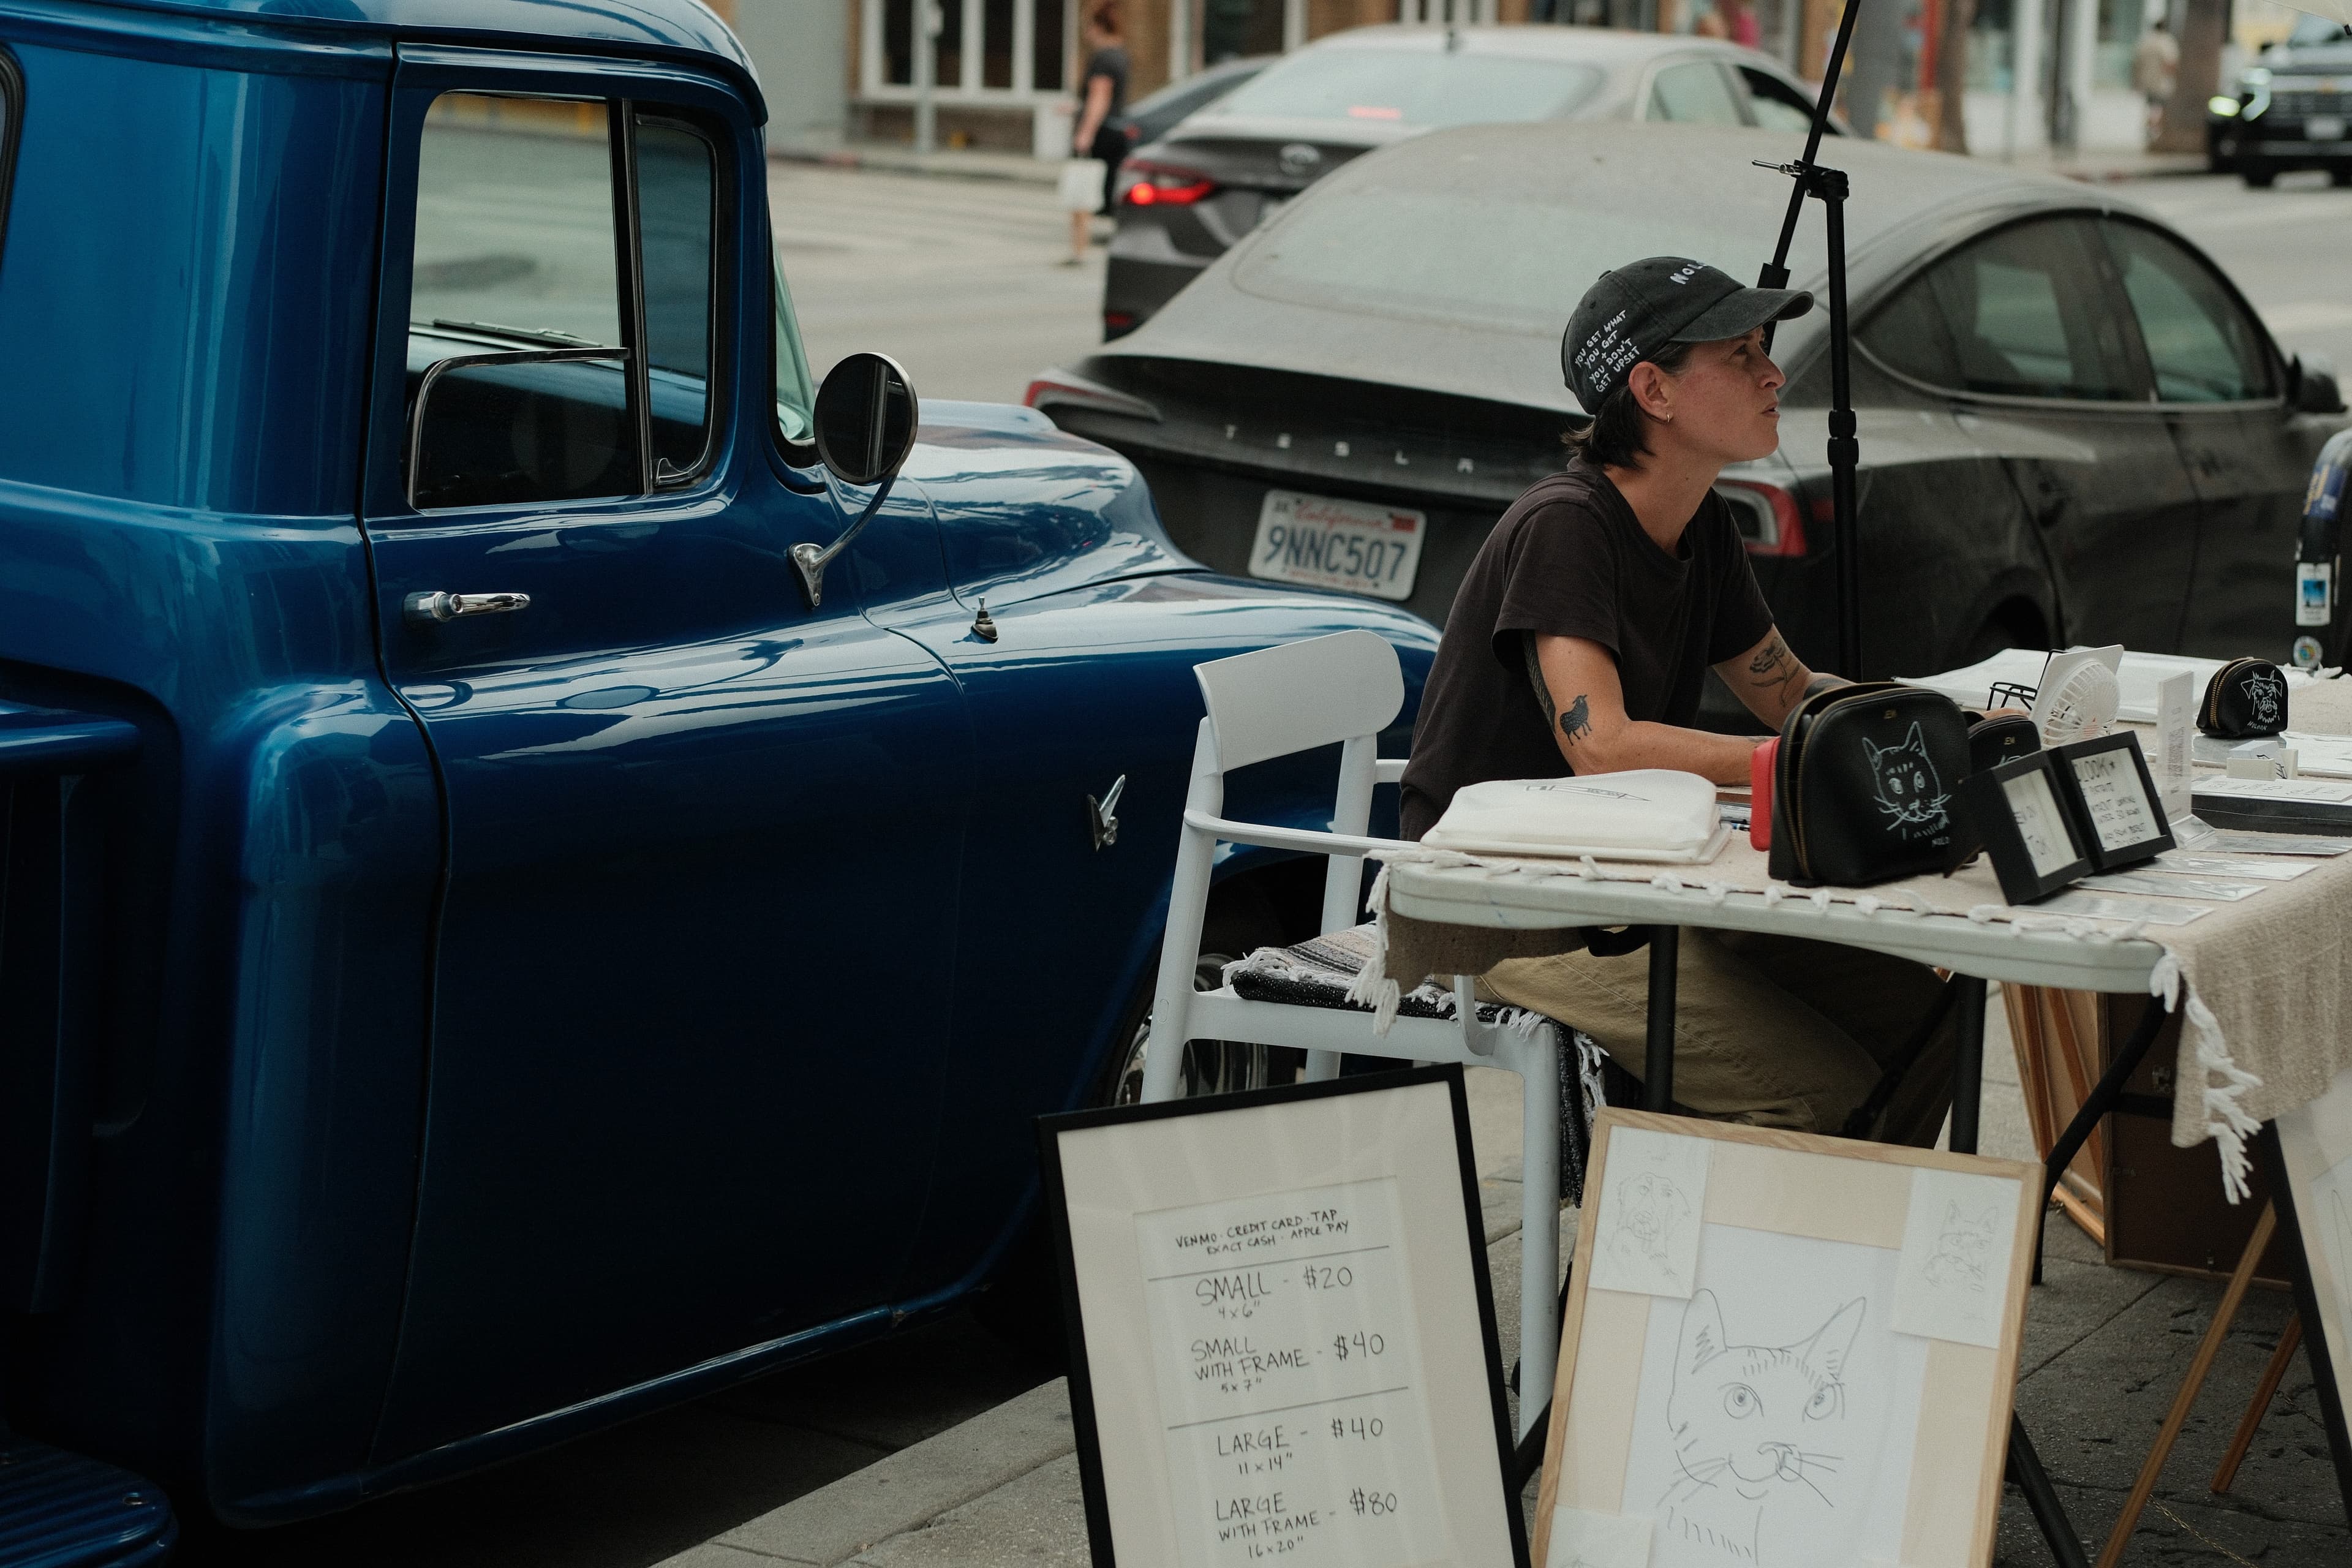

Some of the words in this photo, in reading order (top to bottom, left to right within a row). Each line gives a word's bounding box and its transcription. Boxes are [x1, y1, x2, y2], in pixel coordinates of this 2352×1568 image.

[1670, 262, 1707, 285] NOL
[1575, 347, 1586, 367] YOU
[1586, 331, 1602, 347] GET
[1604, 310, 1627, 333] WHAT
[1584, 350, 1600, 368] YOU
[1601, 330, 1618, 348] GET
[1589, 366, 1605, 383] YOU
[1605, 337, 1632, 366] DON'T
[1596, 373, 1612, 393] GET
[1613, 346, 1641, 373] UPSET
[1264, 525, 1406, 581] 9NNC507
[1176, 1233, 1217, 1248] VENMO
[1227, 1221, 1267, 1238] CREDIT
[1272, 1215, 1303, 1230] CARD
[1311, 1209, 1337, 1223] TAP
[1207, 1241, 1243, 1254] EXACT
[1247, 1235, 1275, 1247] CASH
[1291, 1227, 1321, 1239] APPLE
[1327, 1220, 1349, 1234] PAY
[1196, 1271, 1272, 1306] SMALL
[1303, 1264, 1352, 1289] $20
[1191, 1336, 1256, 1362] SMALL
[1194, 1360, 1233, 1381] WITH
[1238, 1349, 1310, 1375] FRAME
[1333, 1331, 1384, 1361] $40
[1218, 1425, 1291, 1457] LARGE
[1331, 1416, 1384, 1441] $40
[1215, 1491, 1286, 1522] LARGE
[1219, 1523, 1256, 1542] WITH
[1262, 1510, 1320, 1536] FRAME
[1349, 1487, 1397, 1517] $80
